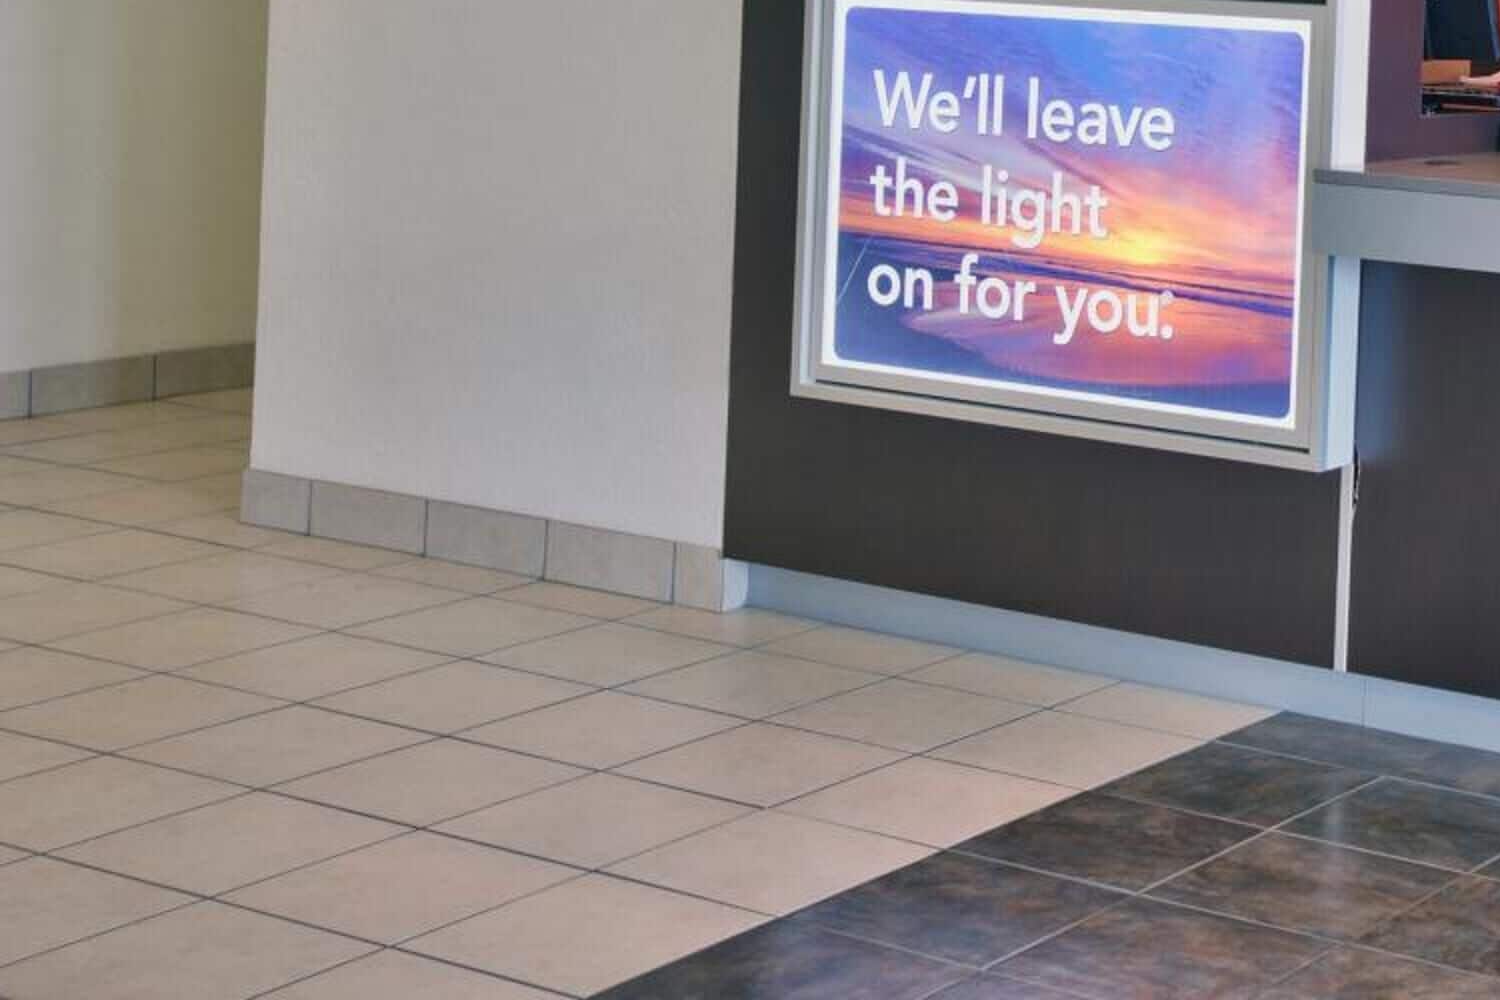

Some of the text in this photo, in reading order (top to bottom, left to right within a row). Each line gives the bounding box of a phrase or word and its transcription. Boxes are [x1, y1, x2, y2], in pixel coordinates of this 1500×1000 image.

[872, 69, 1175, 150] We'll leave
[869, 156, 1109, 249] the light
[866, 262, 933, 311] on
[953, 254, 1037, 322] for
